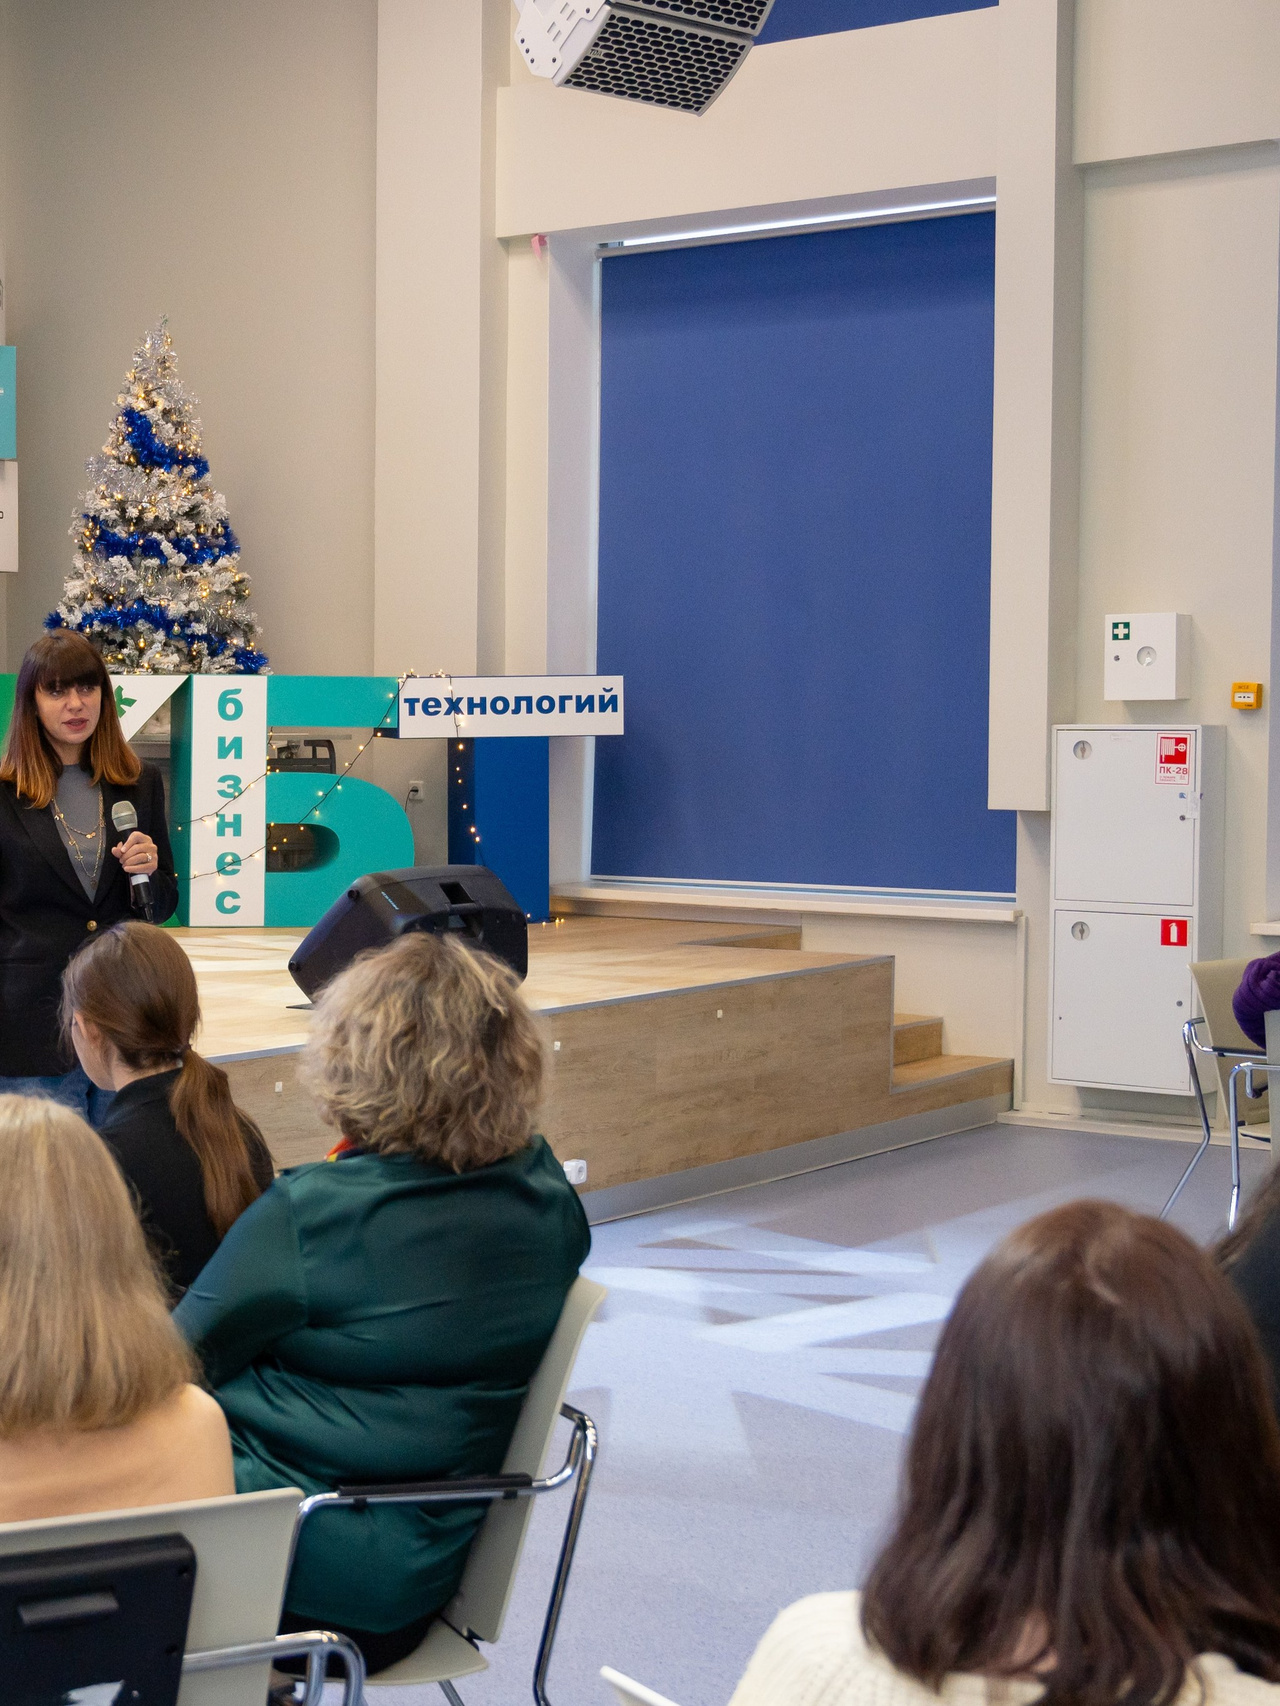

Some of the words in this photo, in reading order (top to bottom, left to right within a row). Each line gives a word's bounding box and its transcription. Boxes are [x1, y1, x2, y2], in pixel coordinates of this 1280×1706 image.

[403, 687, 619, 717] технологий
[1159, 766, 1188, 775] ПК-28
[215, 688, 244, 915] бизнес
